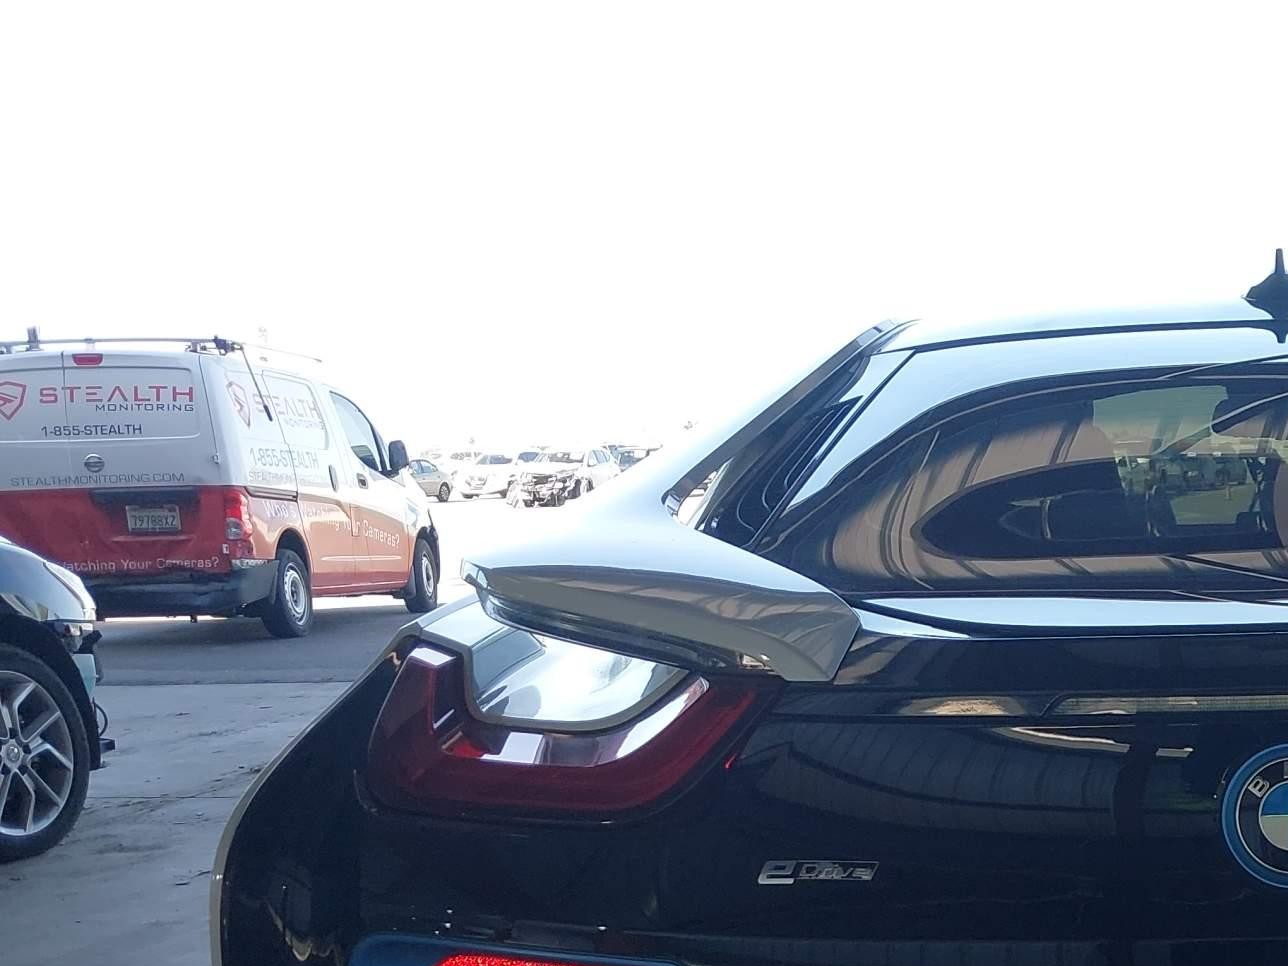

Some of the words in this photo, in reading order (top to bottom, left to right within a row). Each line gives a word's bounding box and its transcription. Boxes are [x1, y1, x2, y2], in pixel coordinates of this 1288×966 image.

[39, 385, 194, 404] STEALTH
[96, 403, 194, 412] MONITORING
[41, 424, 143, 437] 1-855-STEALTH
[10, 472, 186, 488] STEALTHMONITORING.COM
[364, 519, 400, 548] Cameras?
[63, 559, 116, 573] atching
[121, 558, 151, 571] Your
[157, 556, 219, 569] Cameras?
